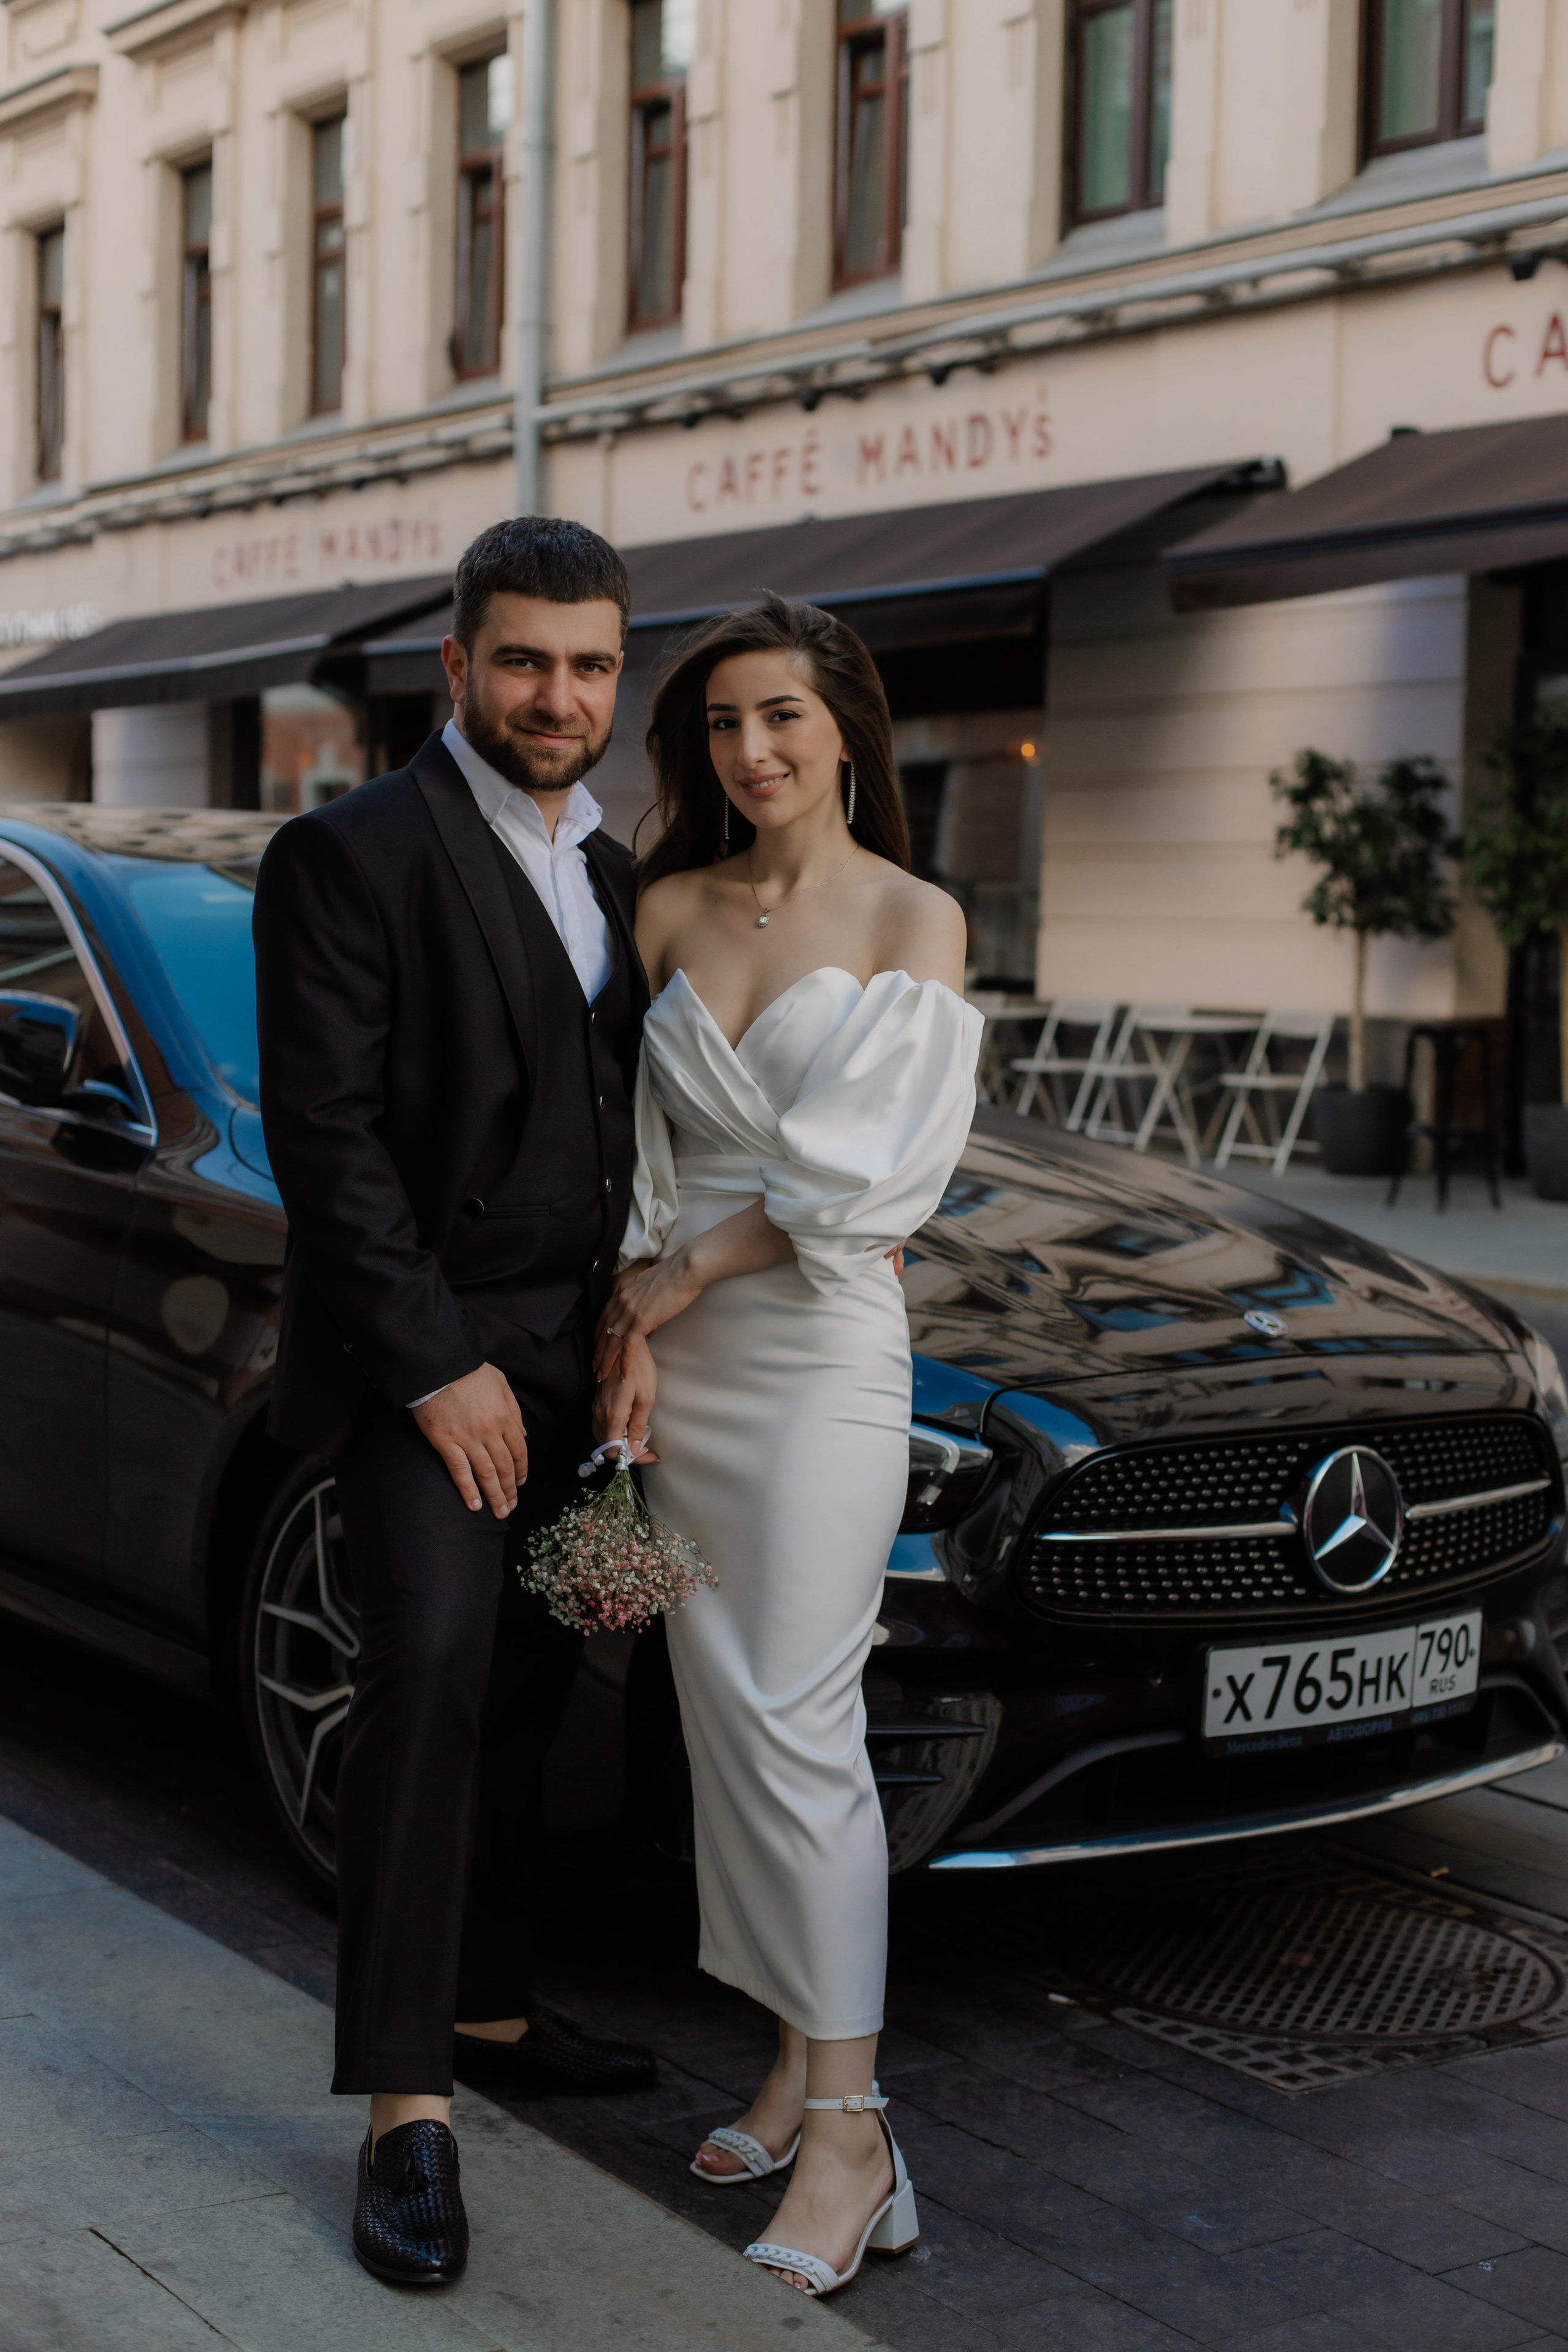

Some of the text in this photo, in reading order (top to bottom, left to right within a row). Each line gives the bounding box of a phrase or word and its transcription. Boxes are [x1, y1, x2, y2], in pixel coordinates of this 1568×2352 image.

[1420, 1624, 1469, 1678] 790
[1430, 1675, 1456, 1695] RUS
[1226, 1735, 1302, 1754] Mercedes-Benz
